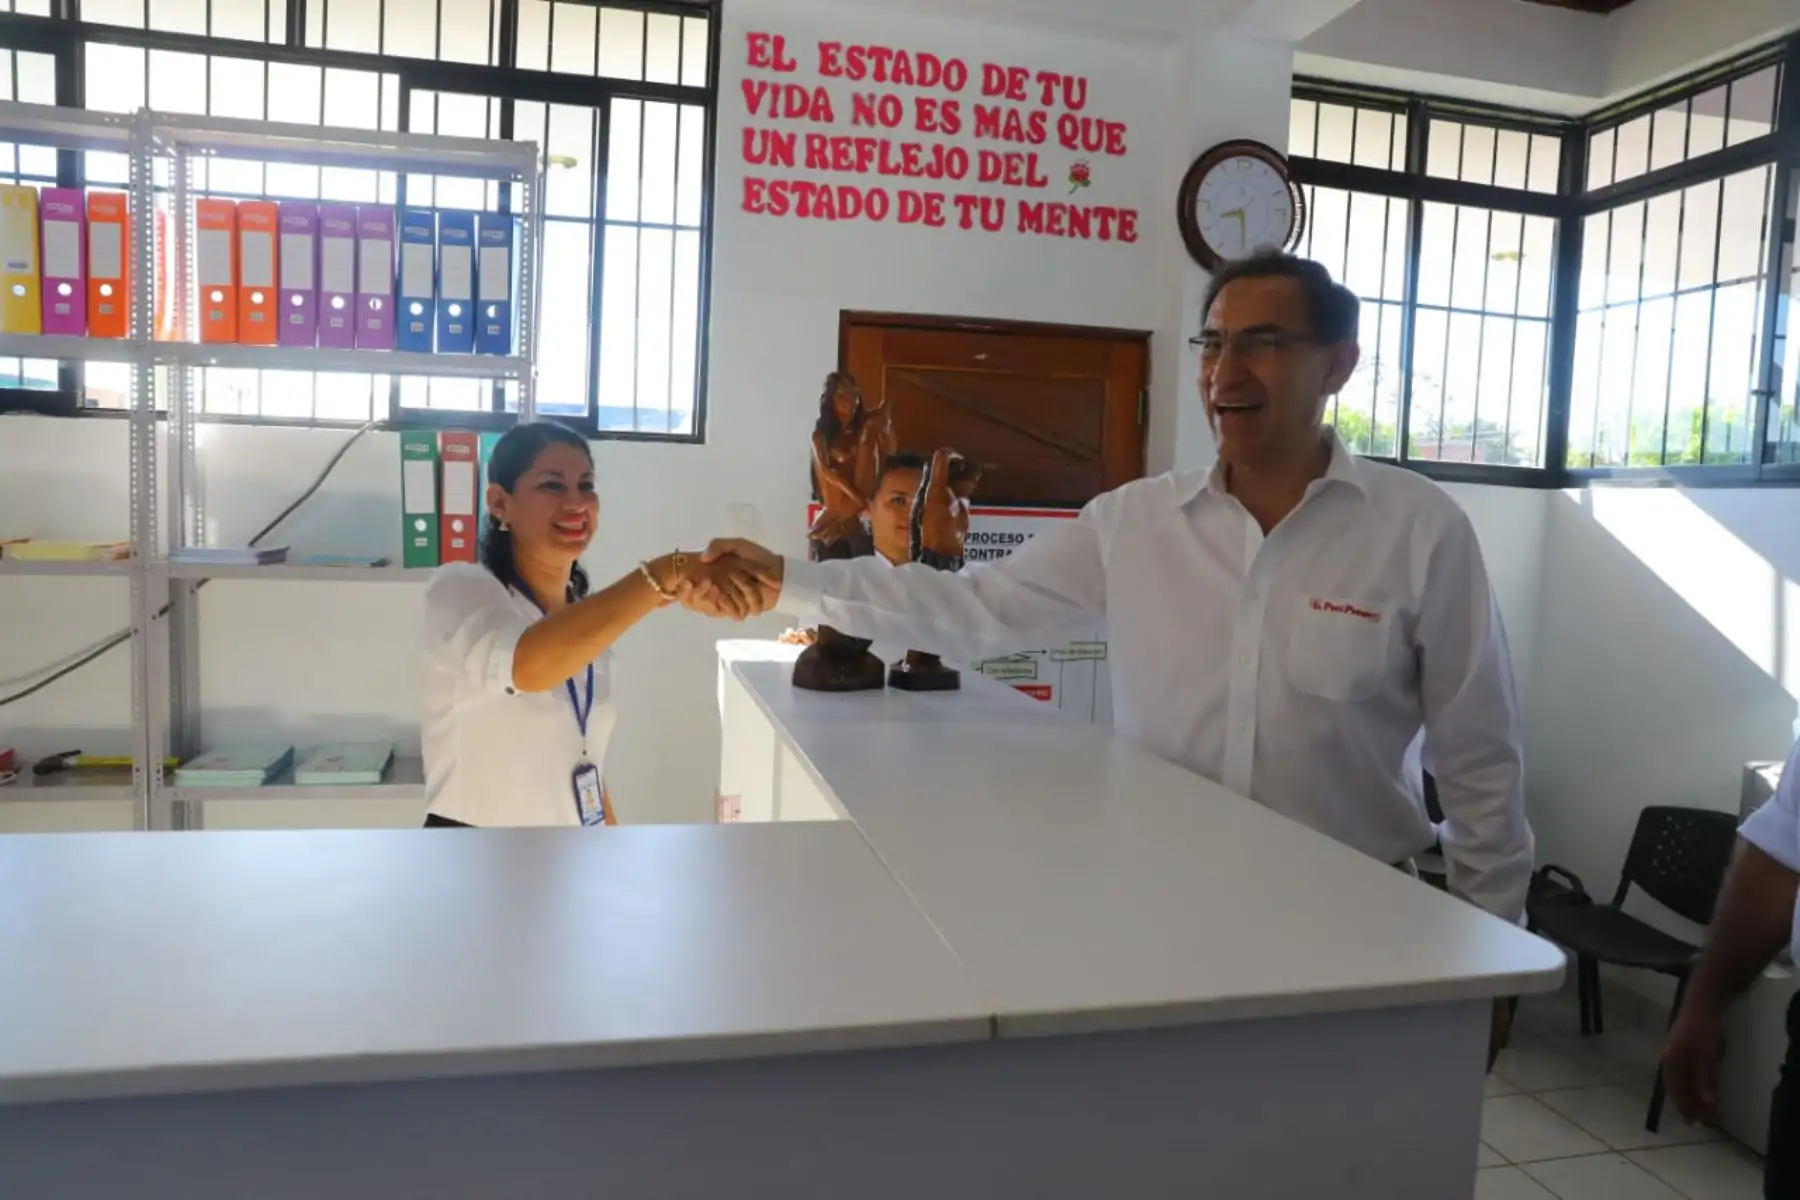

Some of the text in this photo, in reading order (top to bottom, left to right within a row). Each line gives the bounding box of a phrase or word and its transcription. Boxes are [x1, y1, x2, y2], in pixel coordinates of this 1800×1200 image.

[746, 32, 1089, 110] EL ESTADO DE TU
[741, 79, 1127, 156] VIDA NO ES MAS QUE
[741, 126, 1048, 188] UN REFLEJO DEL
[741, 177, 1139, 243] ESTADO DE TU MENTE
